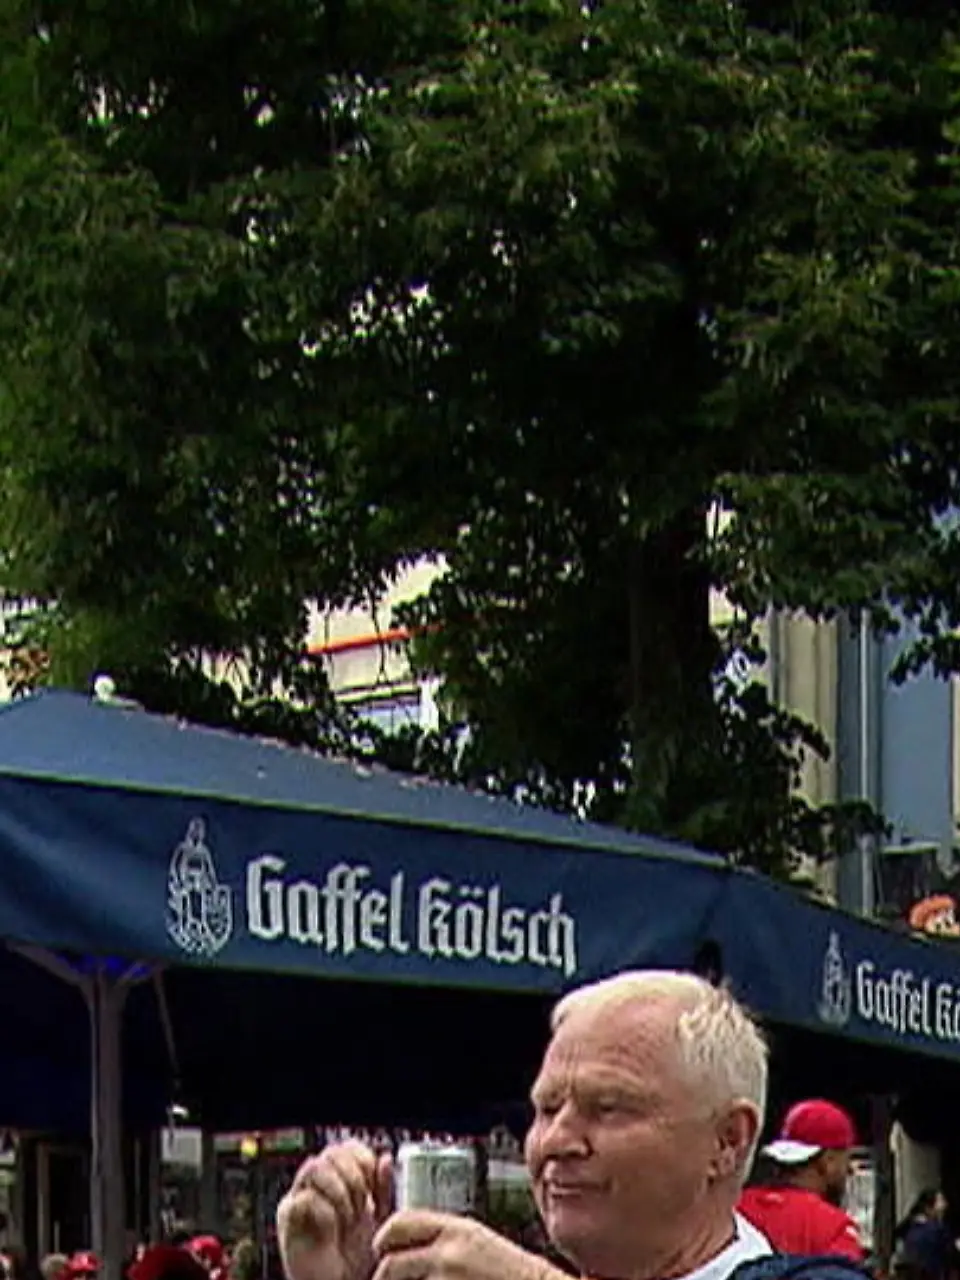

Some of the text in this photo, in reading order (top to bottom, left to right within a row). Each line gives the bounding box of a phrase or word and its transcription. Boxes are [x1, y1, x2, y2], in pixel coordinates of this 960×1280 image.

[246, 854, 578, 977] Gaffel Kölsch
[856, 959, 933, 1036] Gaffel
